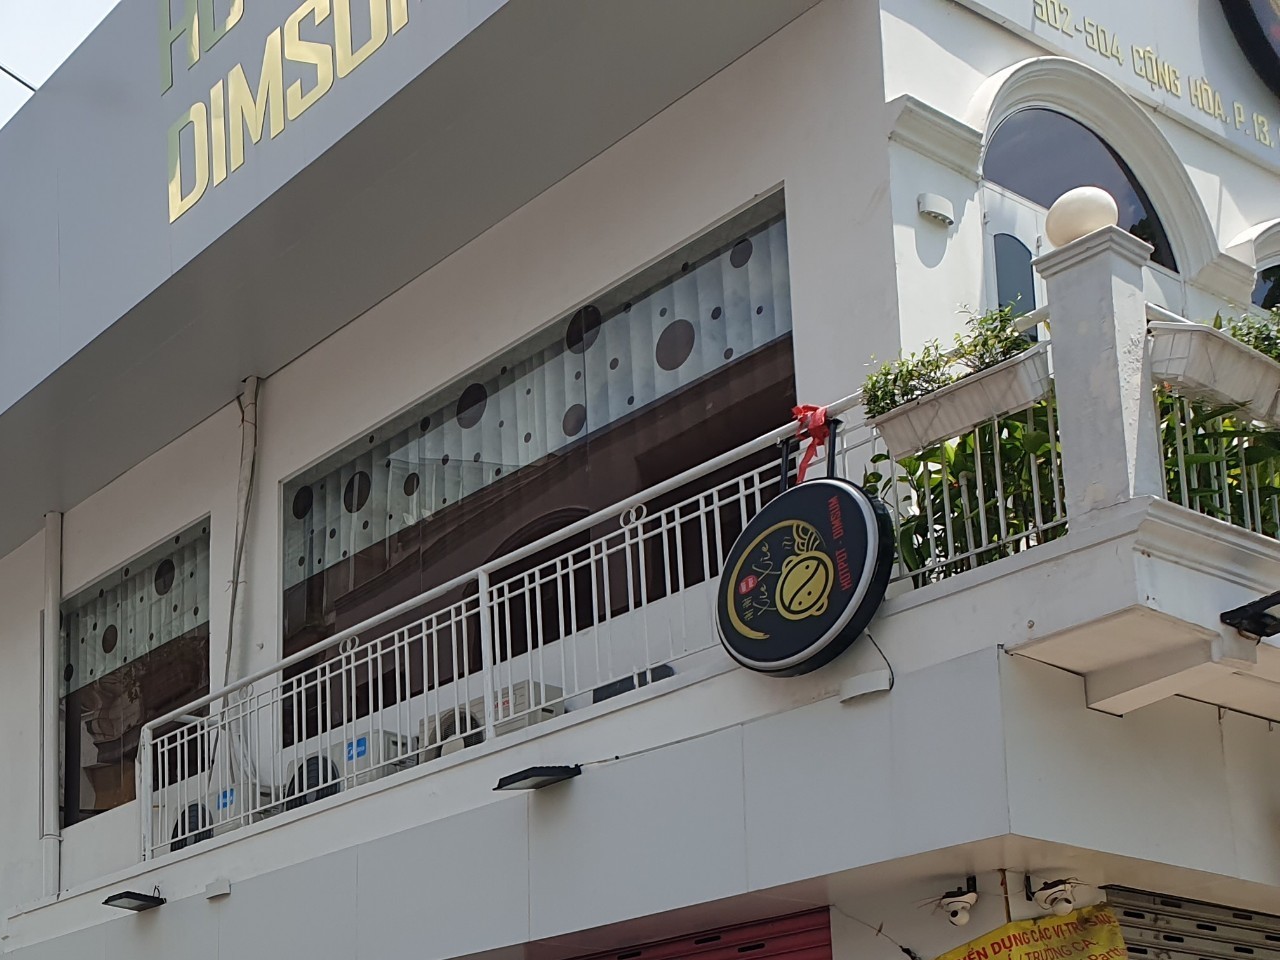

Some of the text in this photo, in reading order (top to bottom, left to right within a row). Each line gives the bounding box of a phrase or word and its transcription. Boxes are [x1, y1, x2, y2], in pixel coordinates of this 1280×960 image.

[1033, 0, 1124, 67] 502-504
[1130, 45, 1181, 99] CỘNG
[167, 0, 410, 225] DIMSU
[835, 548, 852, 591] HOTPOT
[990, 931, 1031, 956] DỤNG
[1030, 924, 1053, 943] CÁC
